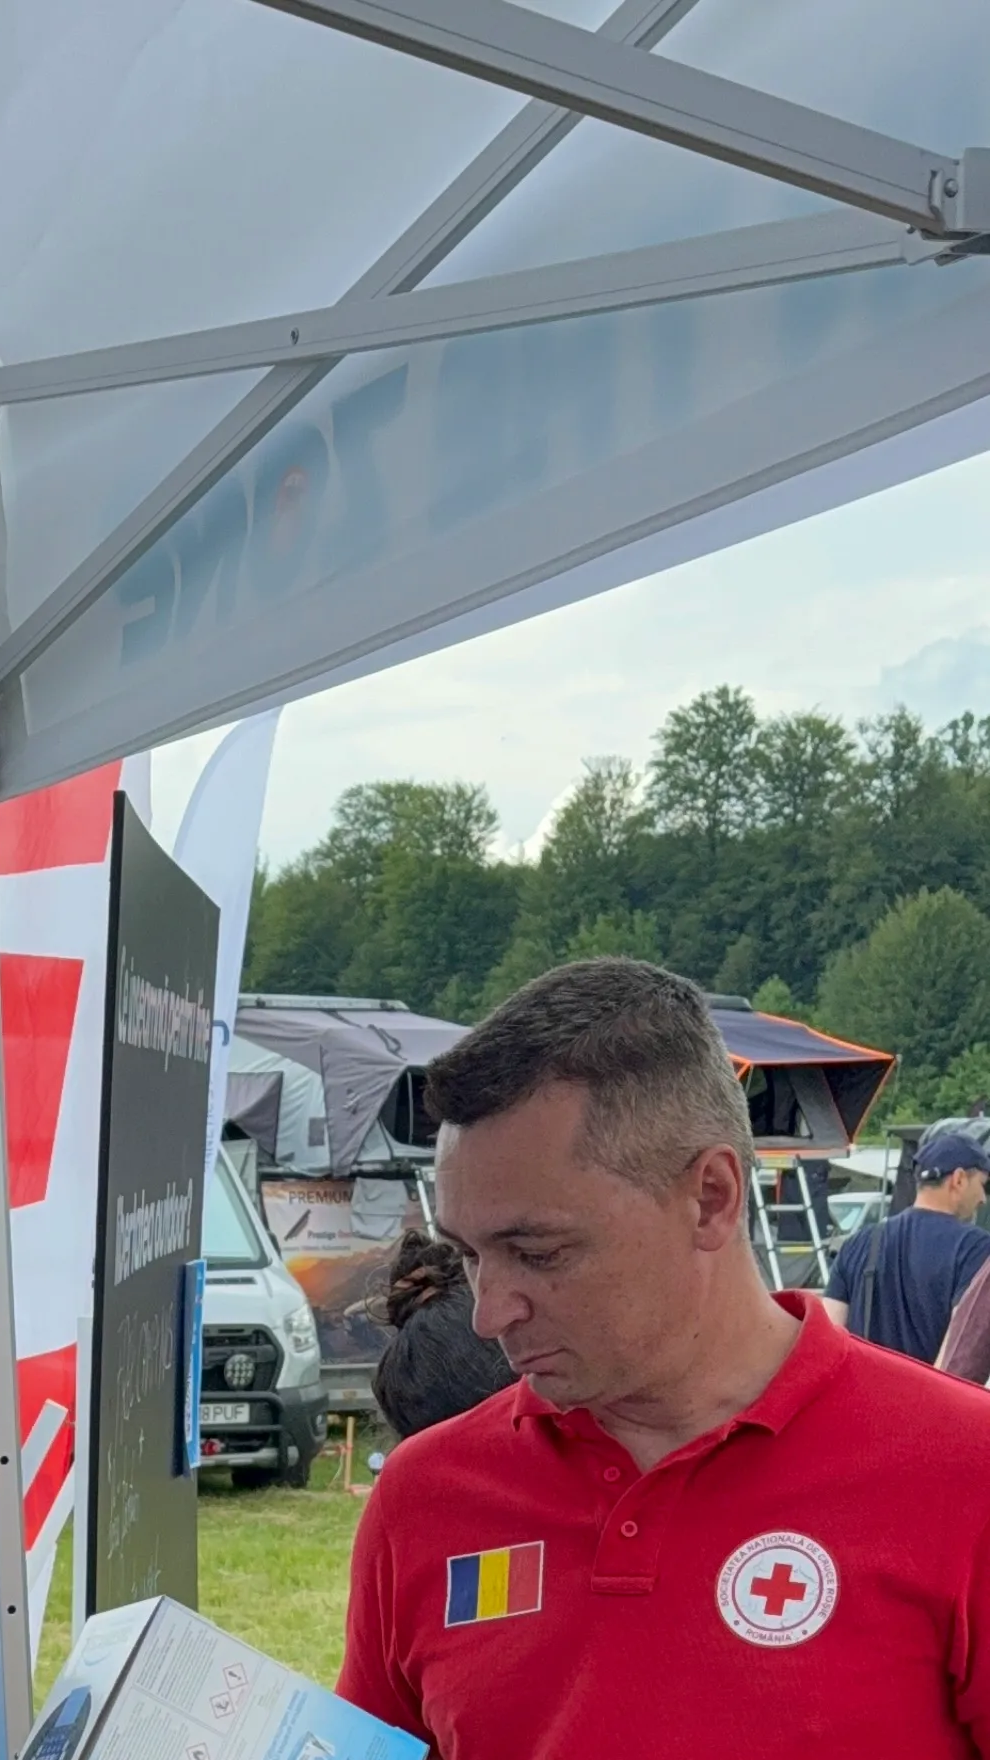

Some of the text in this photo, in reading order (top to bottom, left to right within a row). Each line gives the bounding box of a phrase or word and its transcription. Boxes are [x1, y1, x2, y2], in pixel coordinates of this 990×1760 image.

[212, 1404, 246, 1421] PUF
[720, 1550, 747, 1607] SOCIETATEA
[806, 1541, 821, 1554] DE
[818, 1553, 835, 1584] CRUCE
